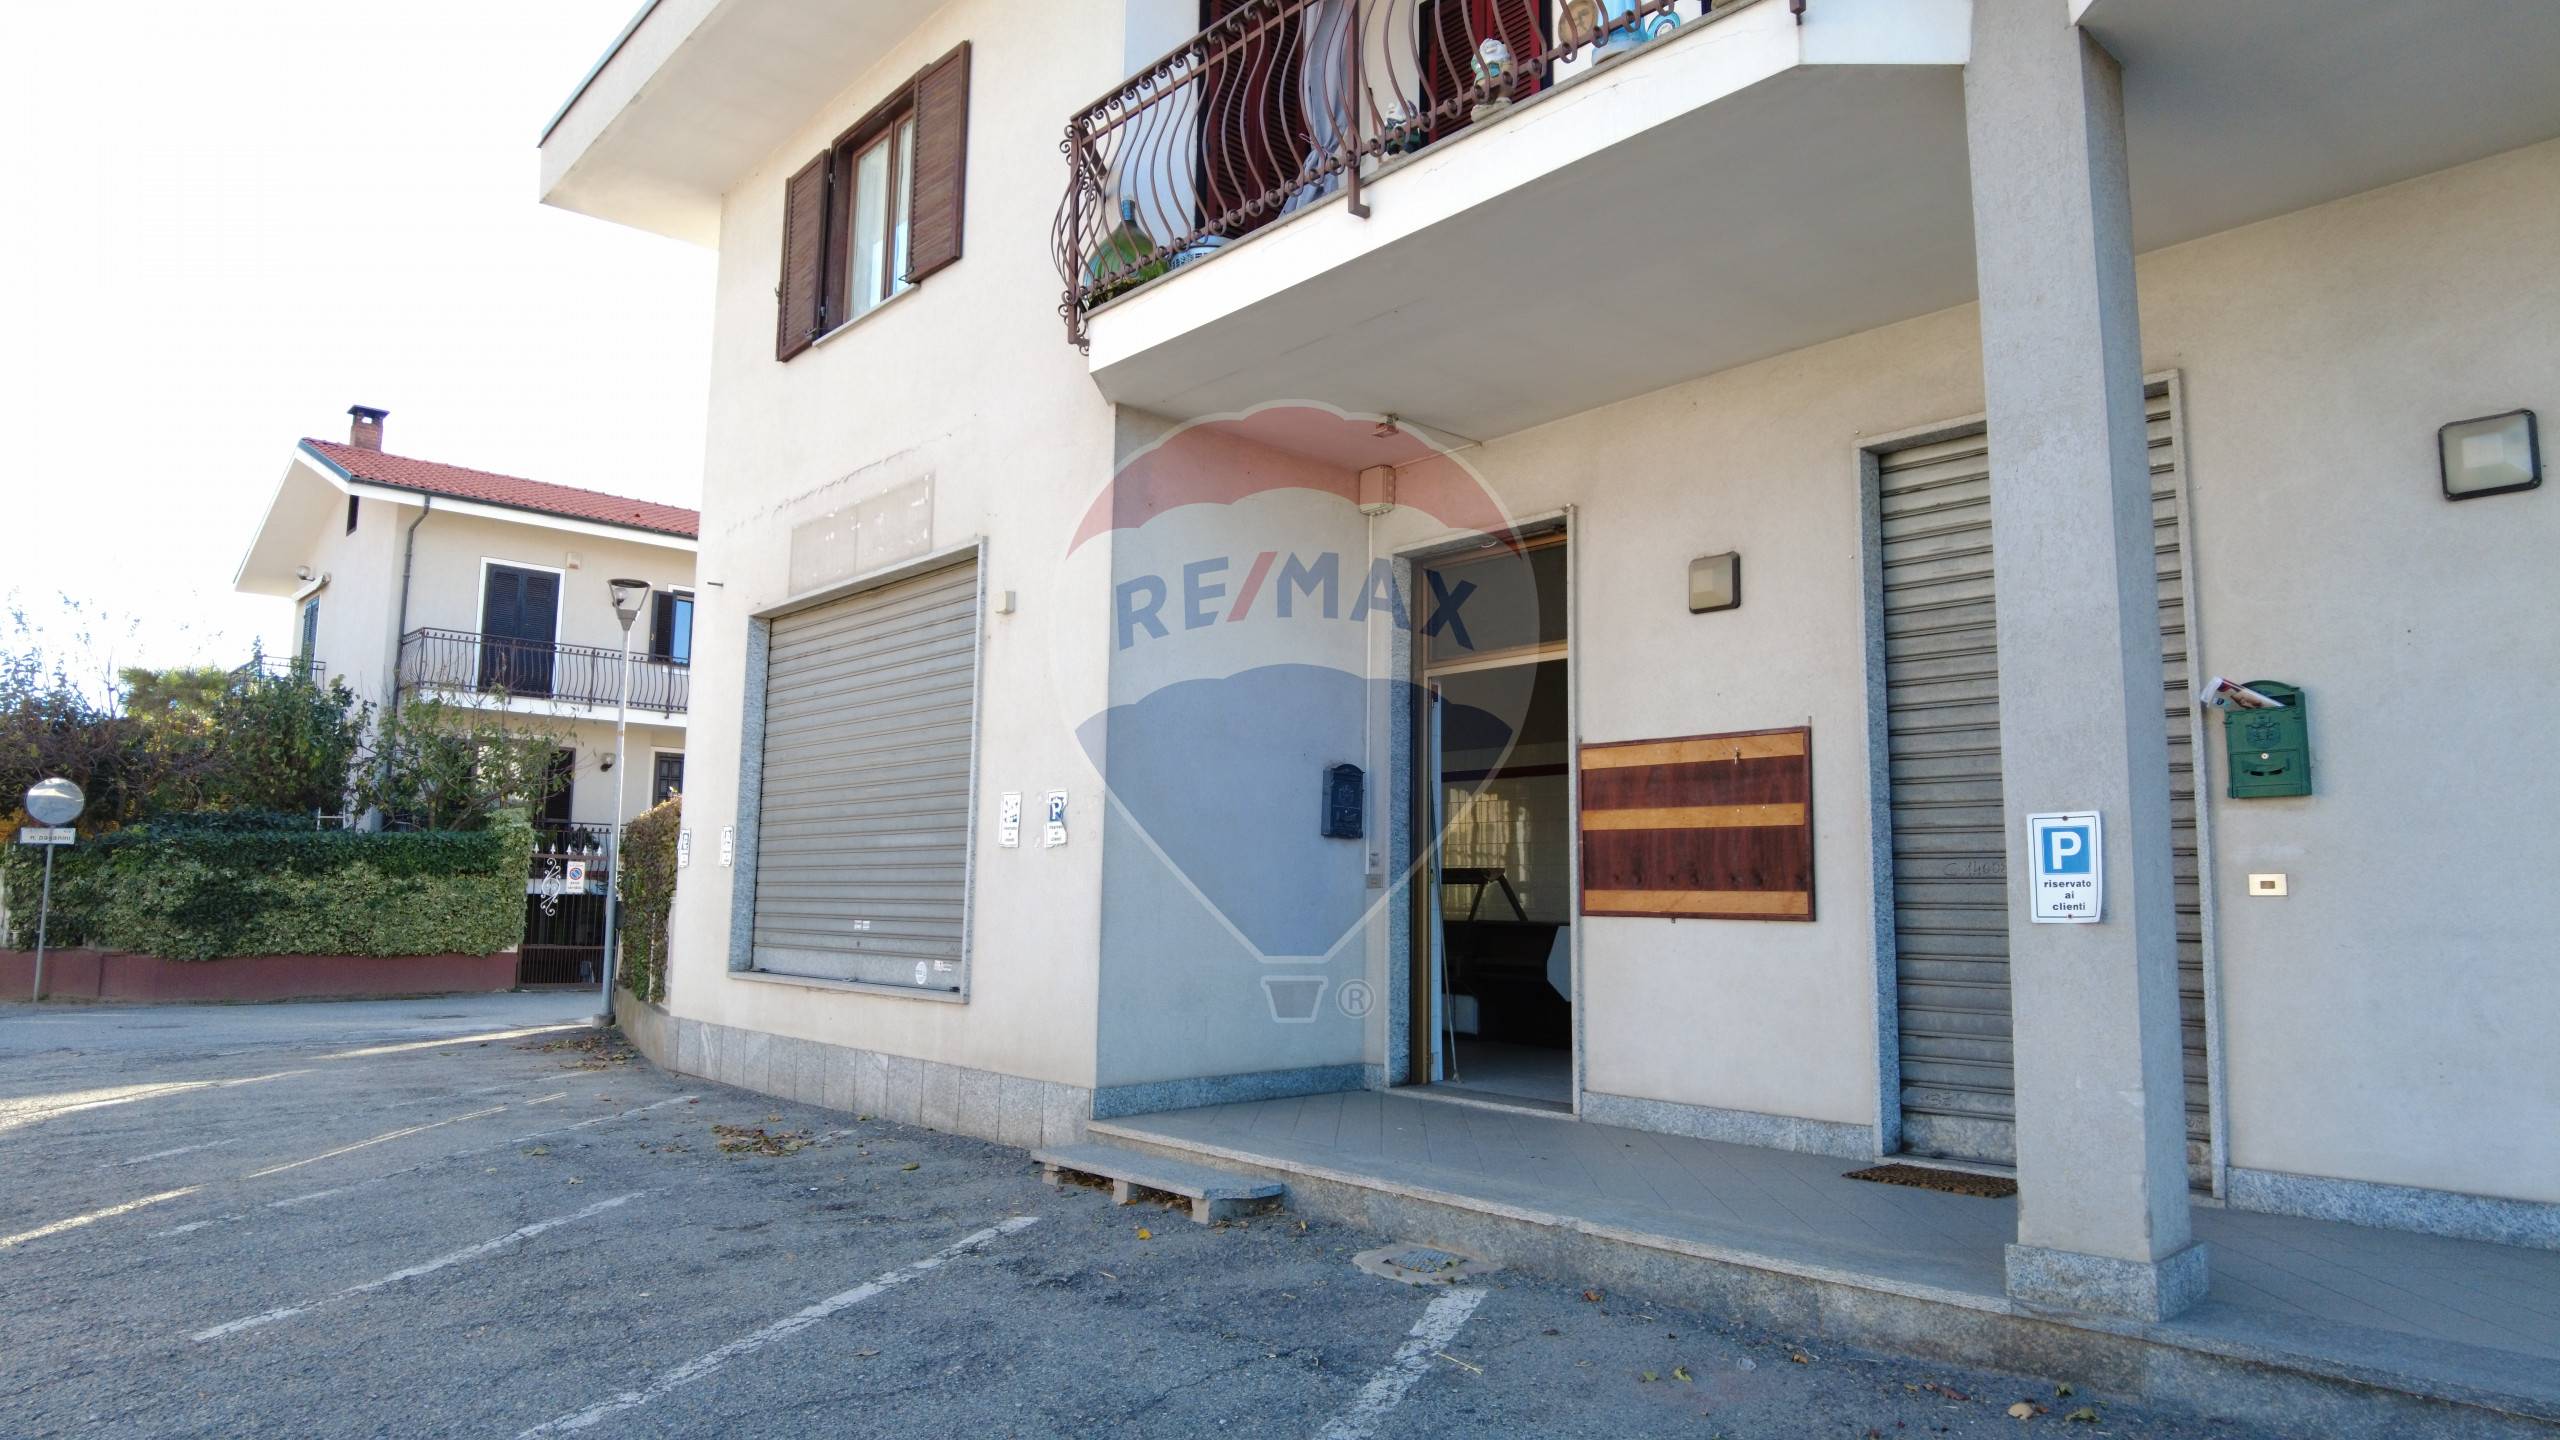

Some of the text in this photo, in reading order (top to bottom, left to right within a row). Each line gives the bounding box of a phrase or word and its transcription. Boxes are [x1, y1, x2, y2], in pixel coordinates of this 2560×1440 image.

[2051, 831, 2082, 870] P
[2043, 879, 2092, 888] riservato
[2064, 890, 2075, 899] ai
[2052, 902, 2086, 911] clienti
